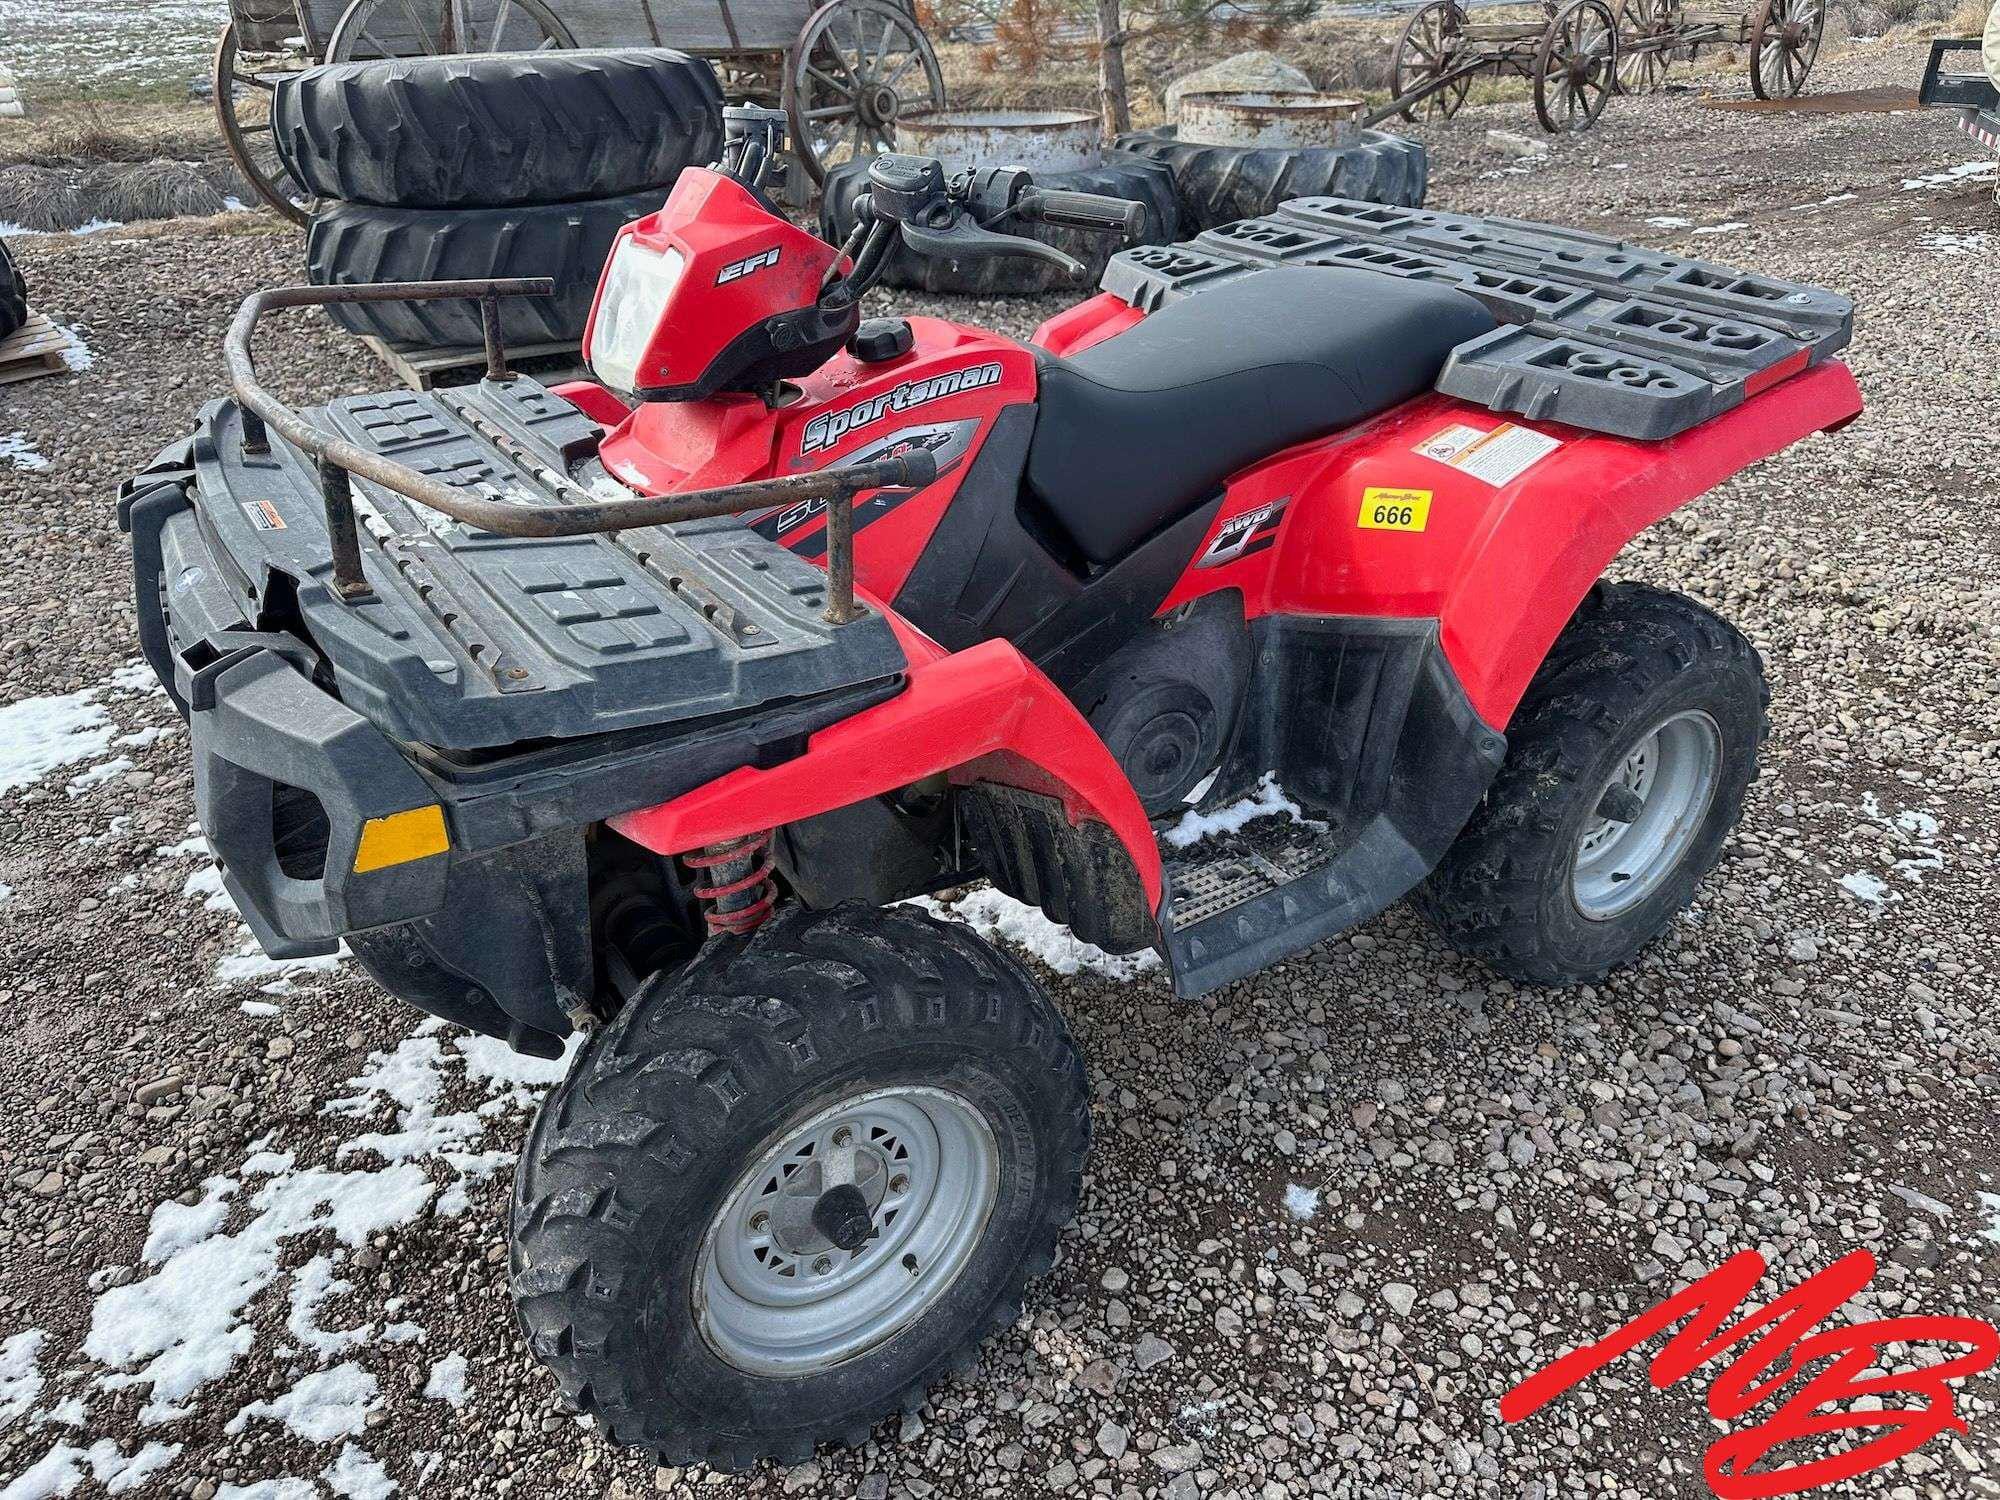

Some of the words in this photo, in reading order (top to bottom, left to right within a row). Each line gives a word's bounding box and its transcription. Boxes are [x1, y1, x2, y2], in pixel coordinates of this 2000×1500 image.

[715, 246, 781, 286] EFI
[801, 363, 1002, 455] Sportsman
[1213, 506, 1272, 539] AWD
[1374, 505, 1412, 525] 666
